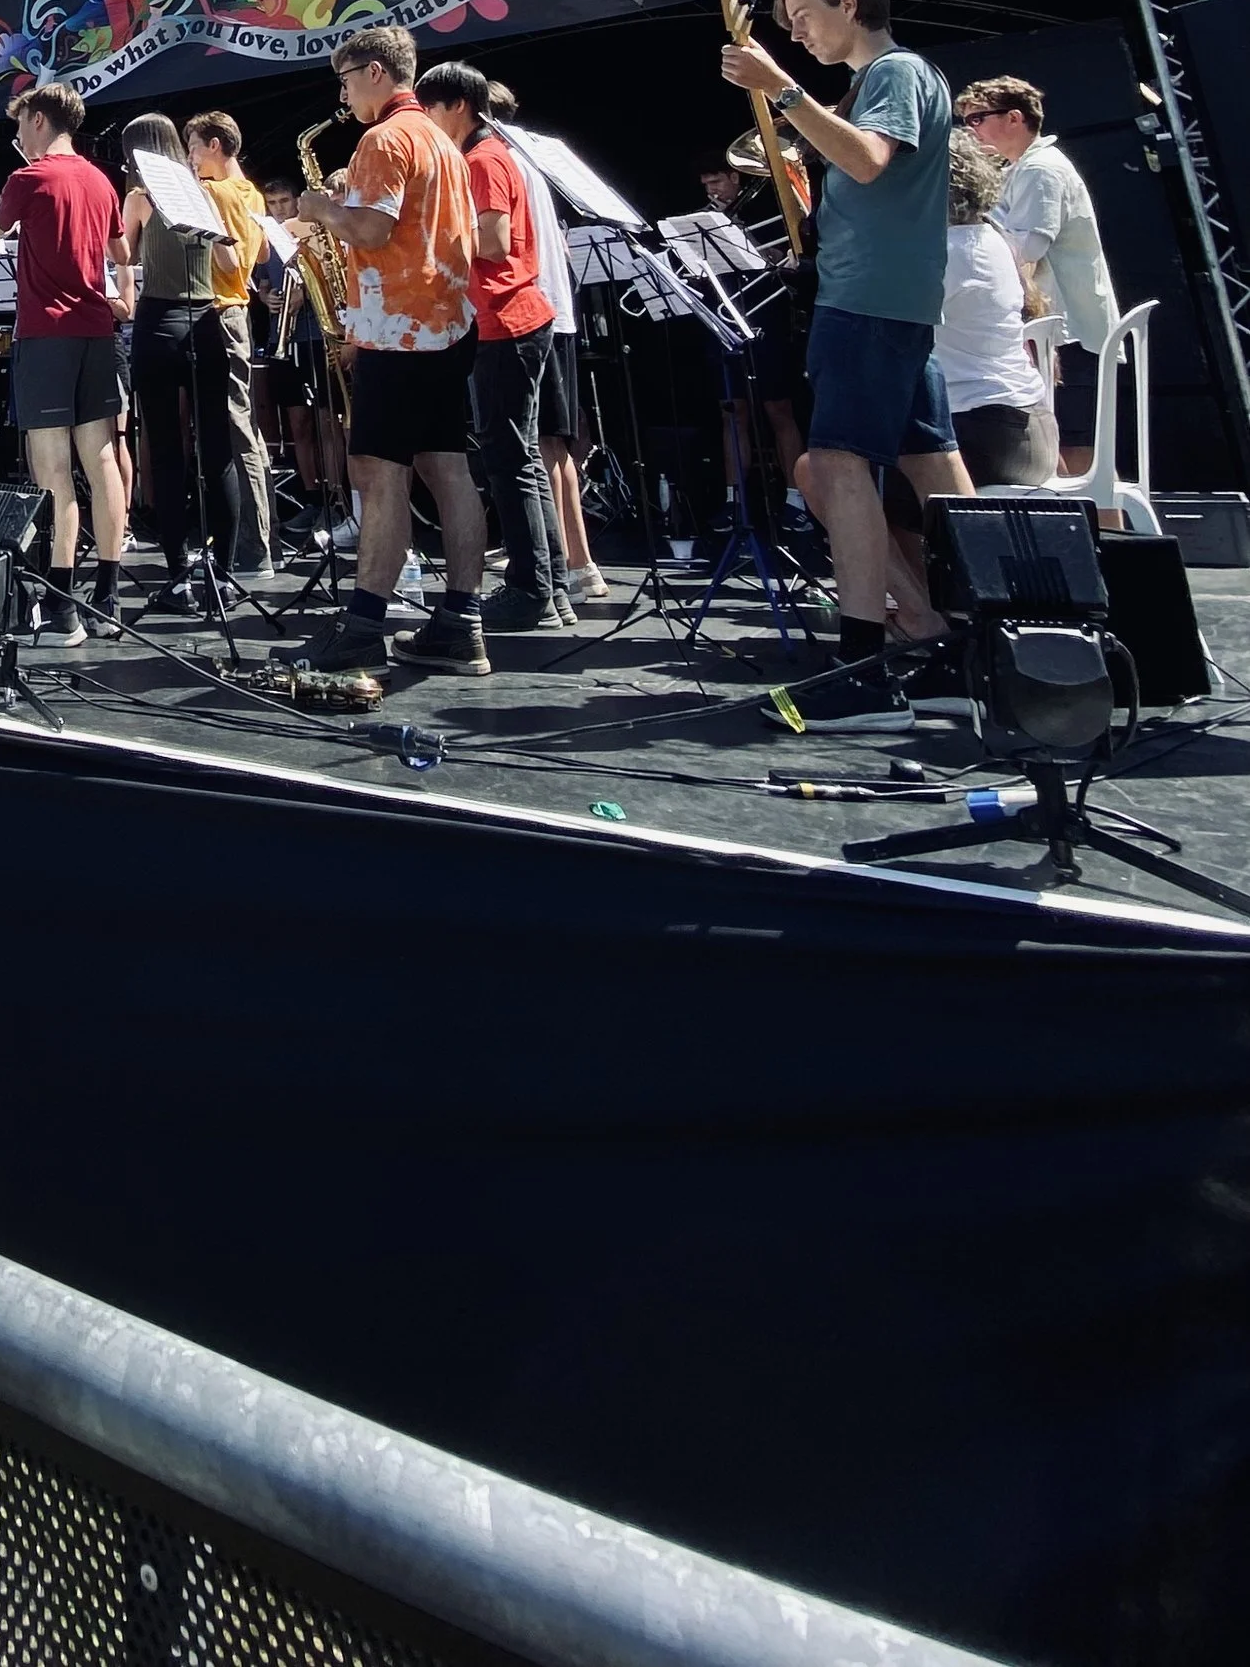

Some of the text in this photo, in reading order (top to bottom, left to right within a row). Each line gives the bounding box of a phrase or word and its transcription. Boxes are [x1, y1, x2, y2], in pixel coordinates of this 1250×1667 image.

[70, 74, 102, 96] Do
[104, 26, 170, 78] what
[175, 20, 223, 42] you
[228, 23, 289, 60] love,
[296, 29, 355, 56] love
